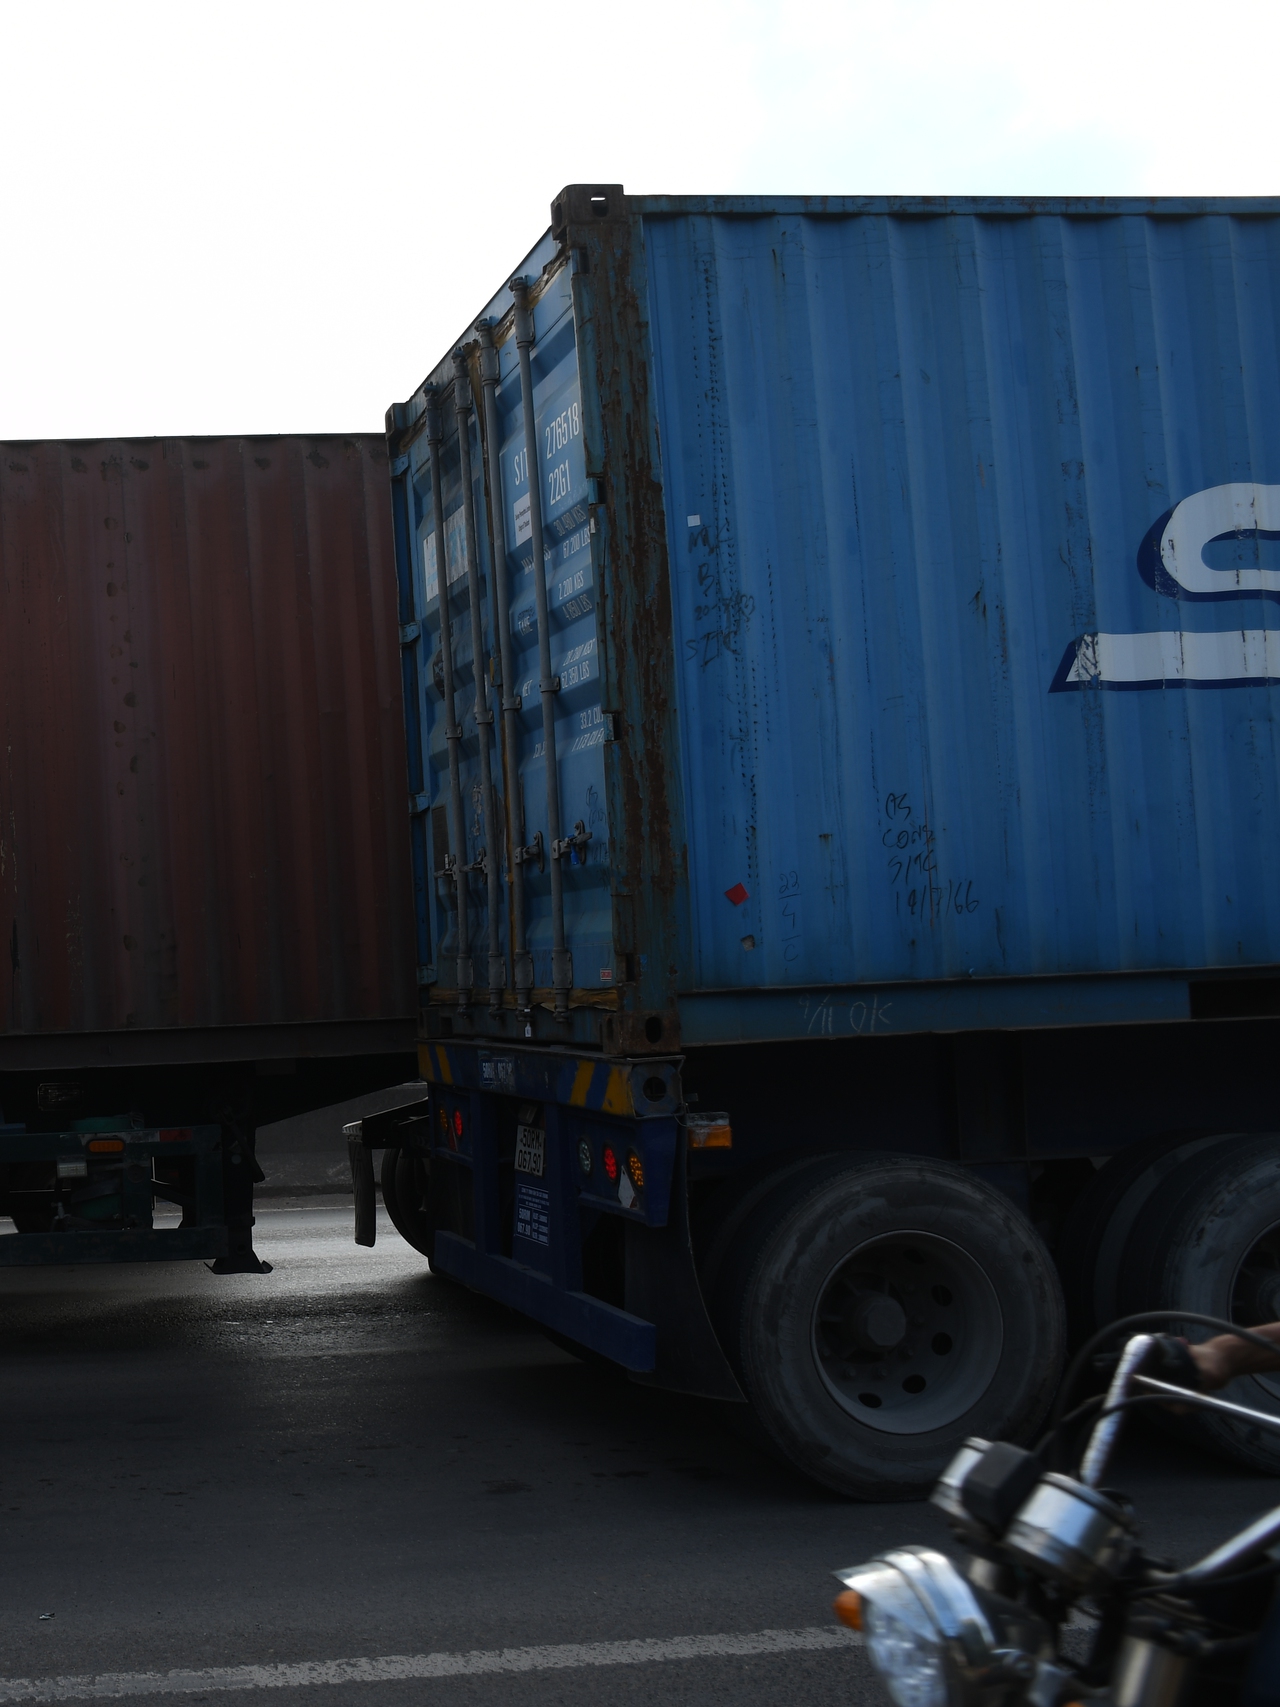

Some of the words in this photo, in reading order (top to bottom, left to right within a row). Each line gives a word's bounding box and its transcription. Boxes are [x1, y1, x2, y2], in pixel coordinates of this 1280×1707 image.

[545, 402, 580, 460] 276518
[548, 459, 571, 506] 22G1
[849, 993, 893, 1034] OK
